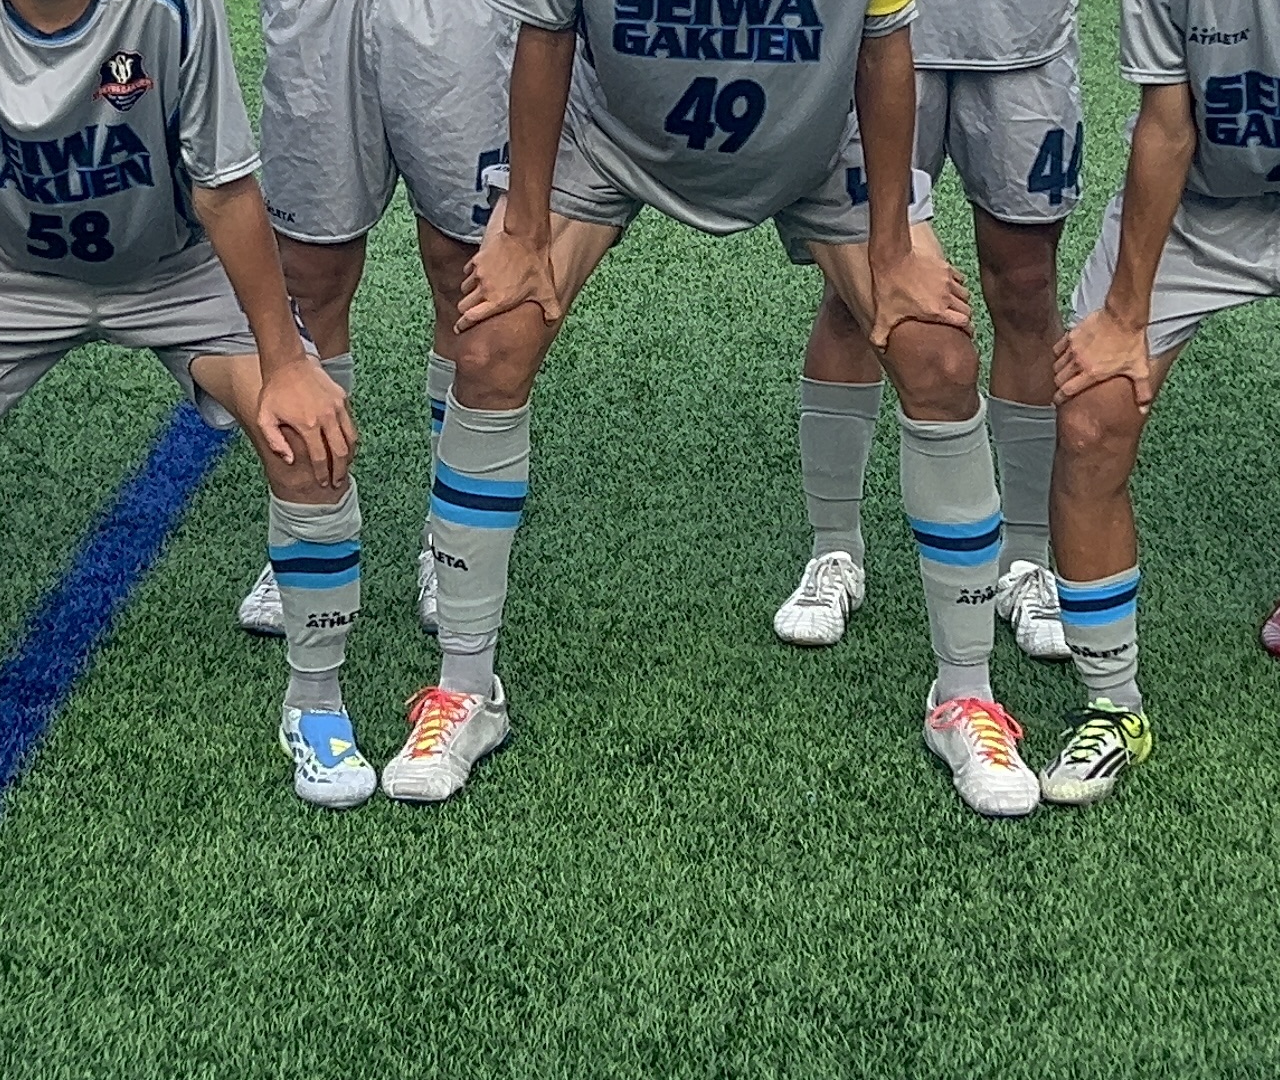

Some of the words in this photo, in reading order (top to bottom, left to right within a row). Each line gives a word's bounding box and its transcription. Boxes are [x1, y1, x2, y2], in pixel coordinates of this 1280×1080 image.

[613, 23, 823, 63] GAKUEN
[663, 76, 767, 153] 49
[472, 142, 509, 225] 5
[27, 210, 115, 262] 58
[432, 546, 468, 571] LETA
[306, 610, 361, 628] ATHLE
